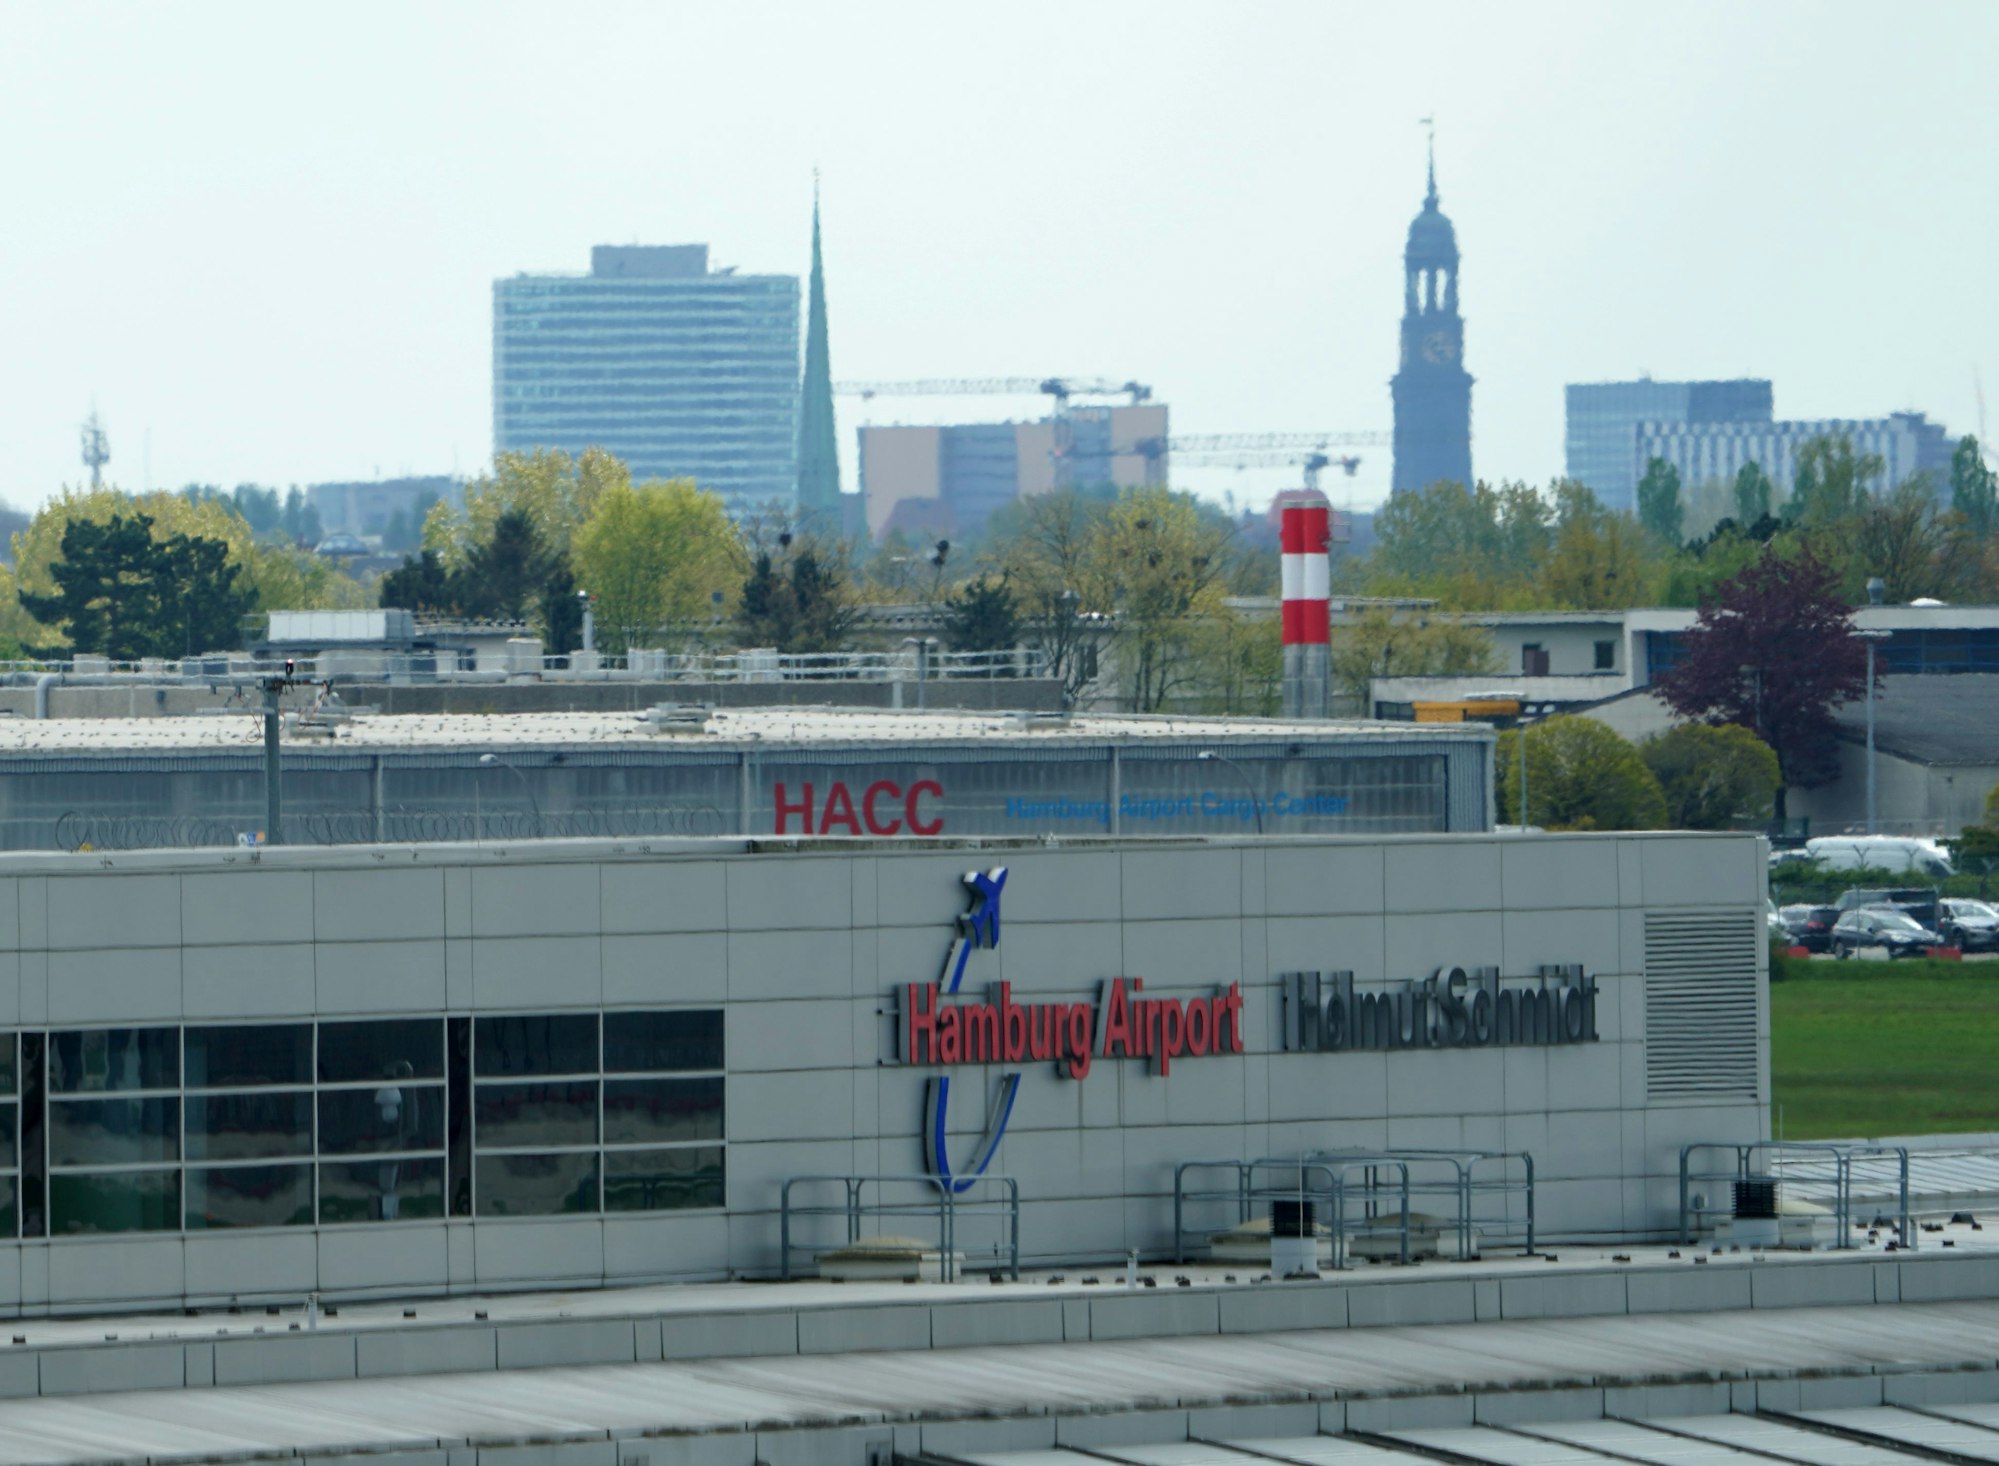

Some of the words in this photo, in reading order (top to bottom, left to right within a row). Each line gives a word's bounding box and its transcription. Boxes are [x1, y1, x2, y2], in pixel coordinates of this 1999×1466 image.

[774, 780, 944, 836] HACC
[1007, 796, 1110, 825] Hamburg
[1118, 793, 1194, 821] Airport
[1201, 790, 1268, 821] Cargo
[902, 980, 1092, 1081] Hamburg
[1100, 976, 1244, 1077] Airport
